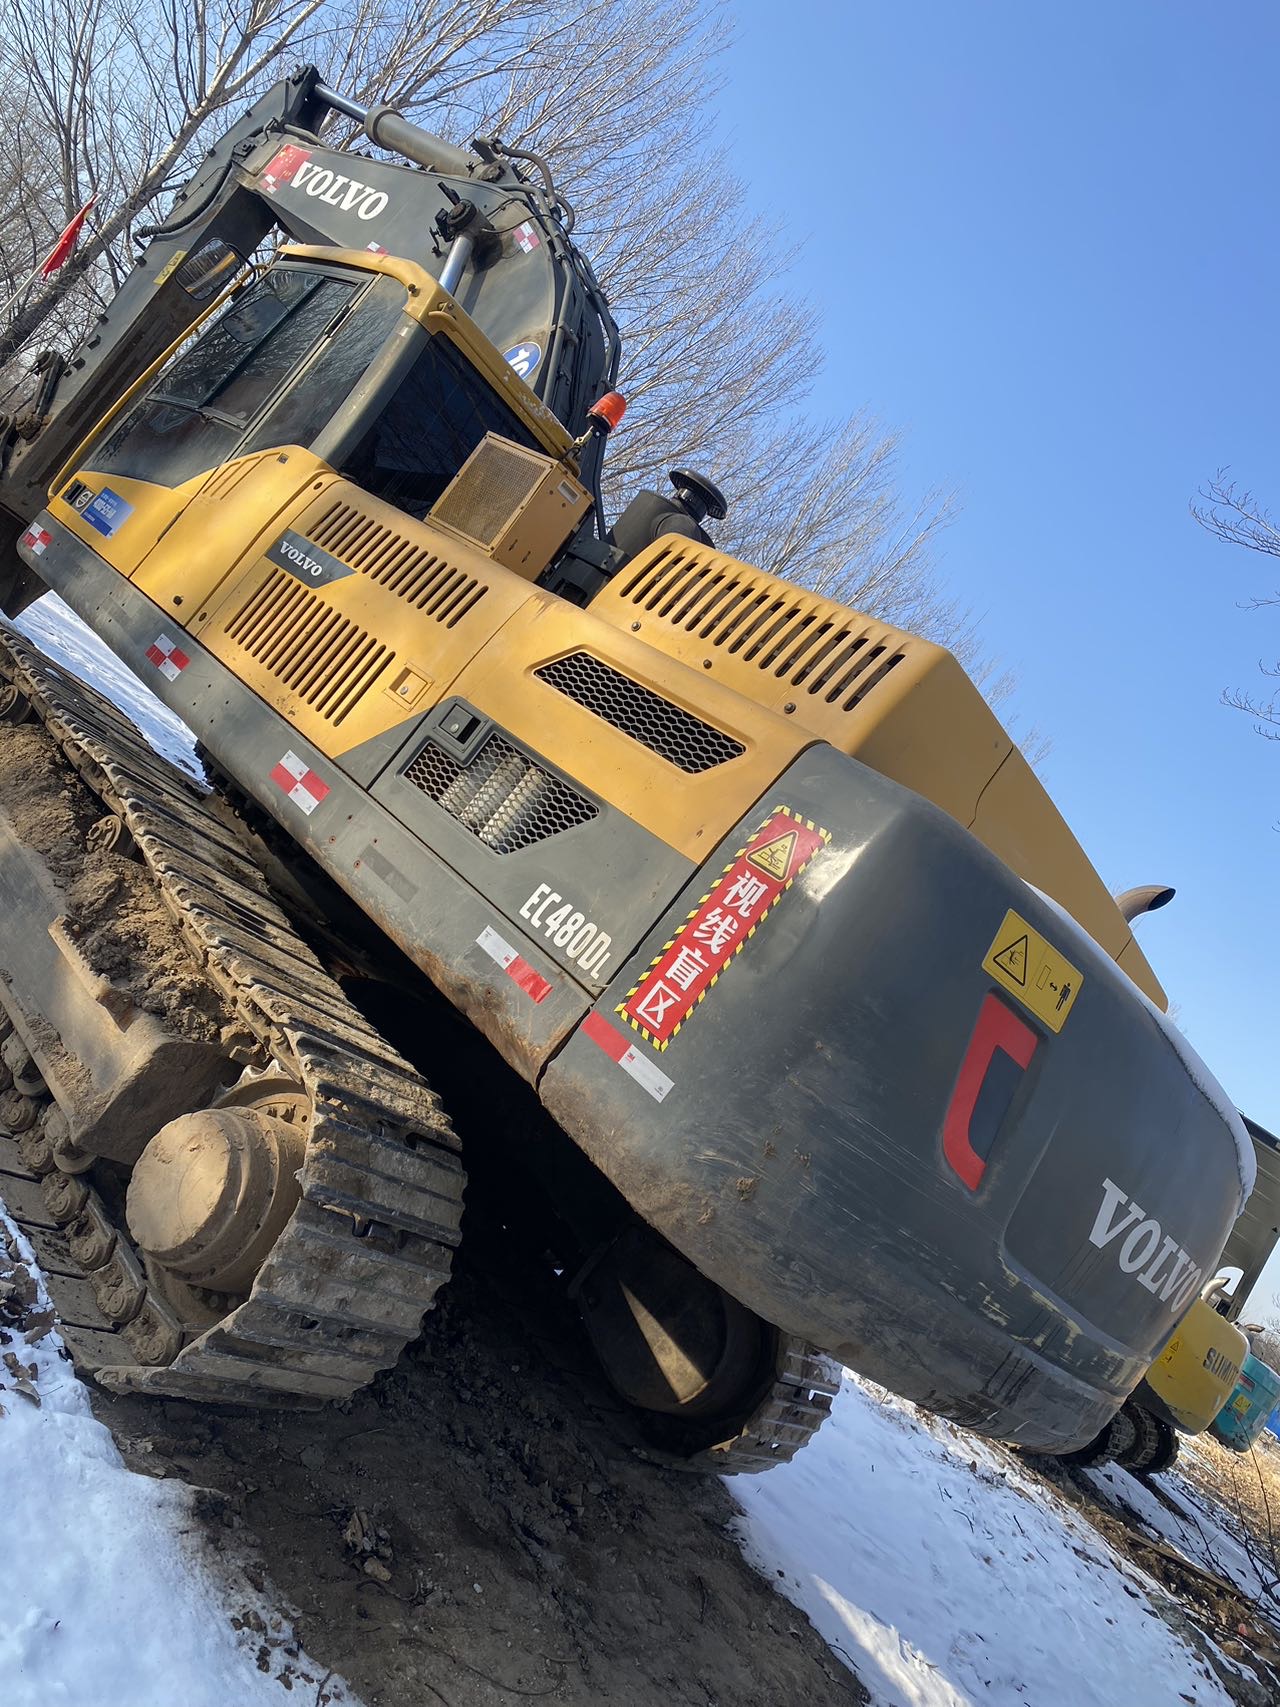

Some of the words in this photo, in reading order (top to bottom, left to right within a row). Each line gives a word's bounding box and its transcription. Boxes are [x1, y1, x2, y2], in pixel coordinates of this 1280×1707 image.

[290, 161, 389, 220] VOLVO
[280, 541, 322, 576] VOLVO
[636, 870, 768, 1029] 视线盲区
[1088, 1178, 1202, 1313] VOLVO
